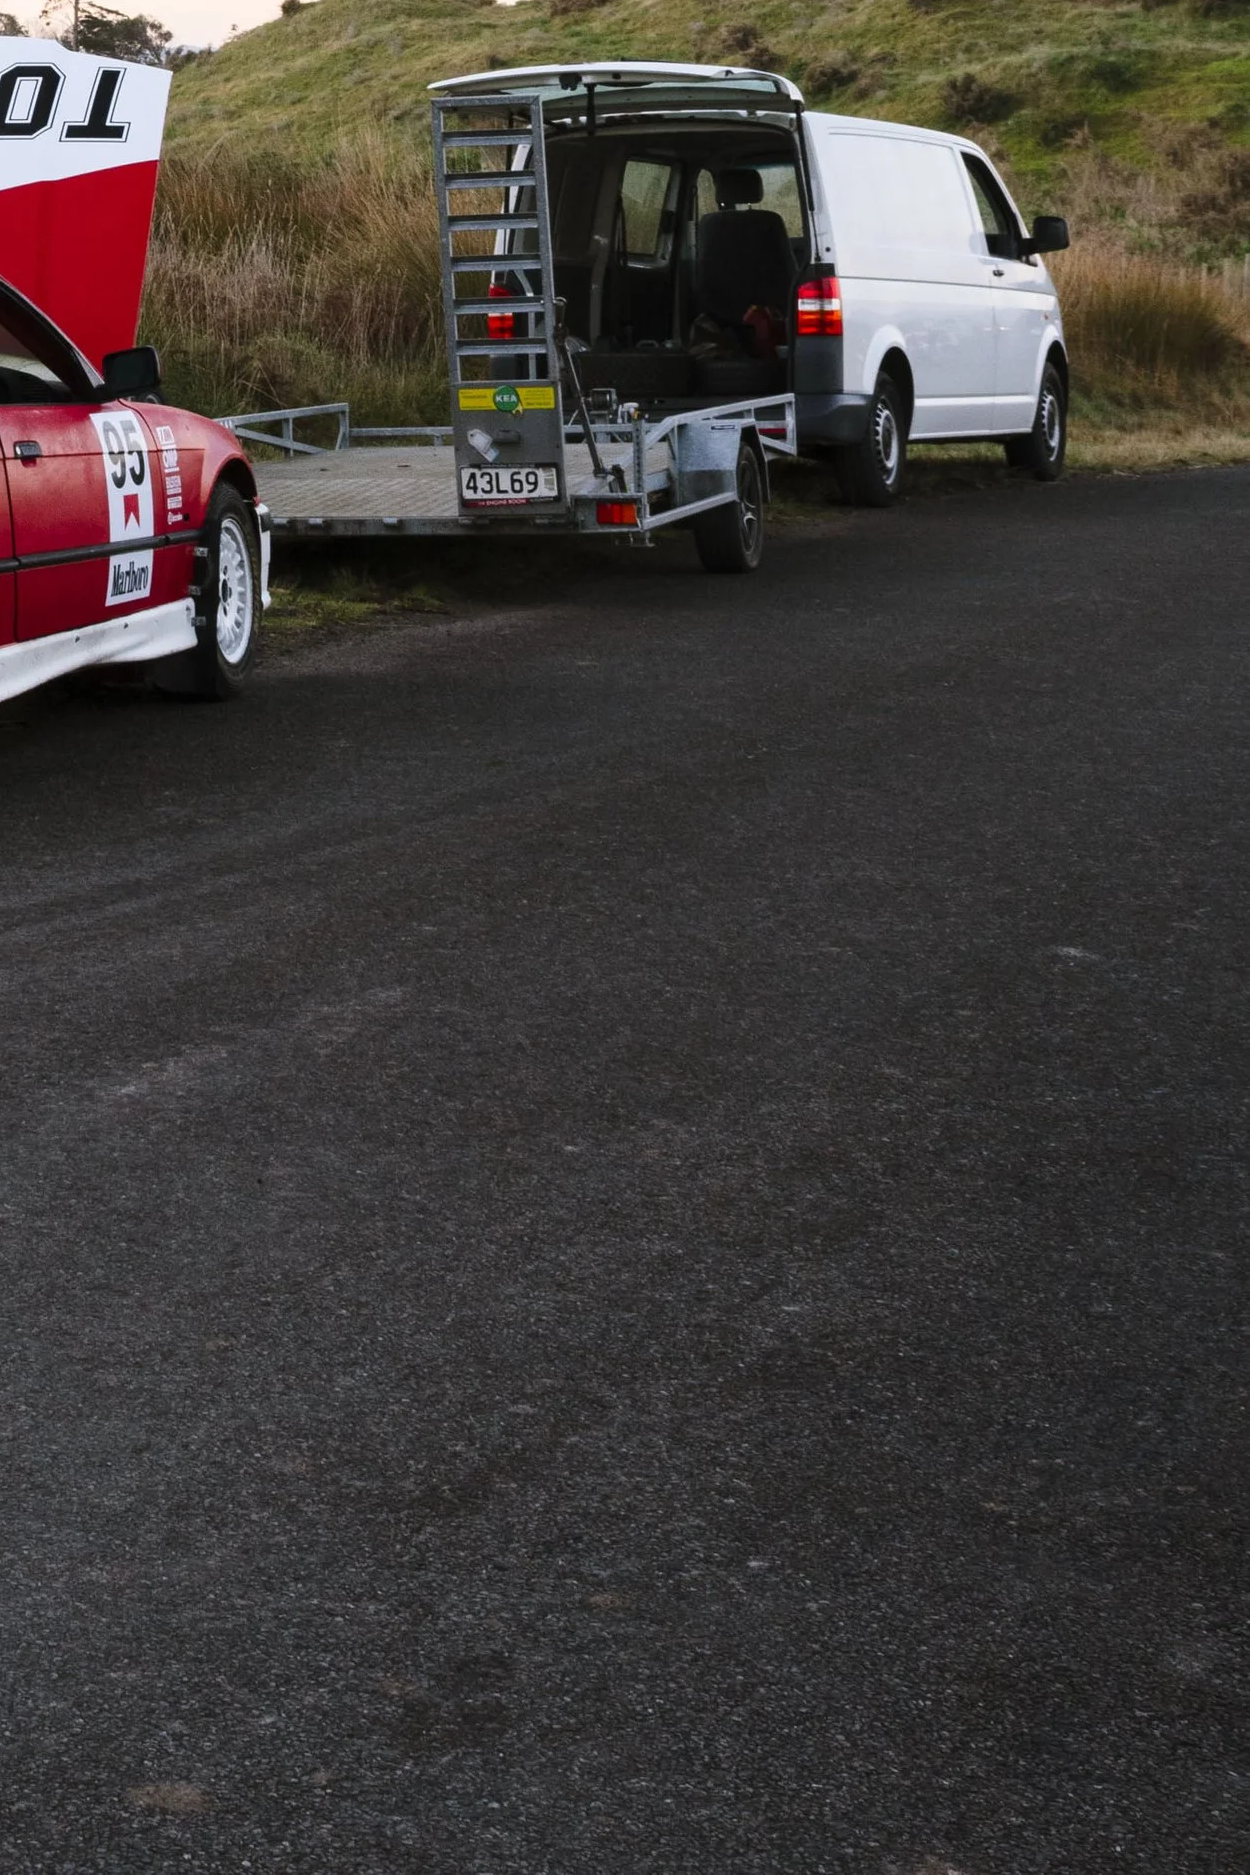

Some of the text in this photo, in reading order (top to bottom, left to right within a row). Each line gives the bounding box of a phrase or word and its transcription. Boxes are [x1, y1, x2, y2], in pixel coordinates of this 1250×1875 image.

[495, 394, 517, 403] KEA
[102, 419, 145, 489] 95
[466, 471, 539, 494] 43L69
[111, 561, 149, 597] Marlboro
